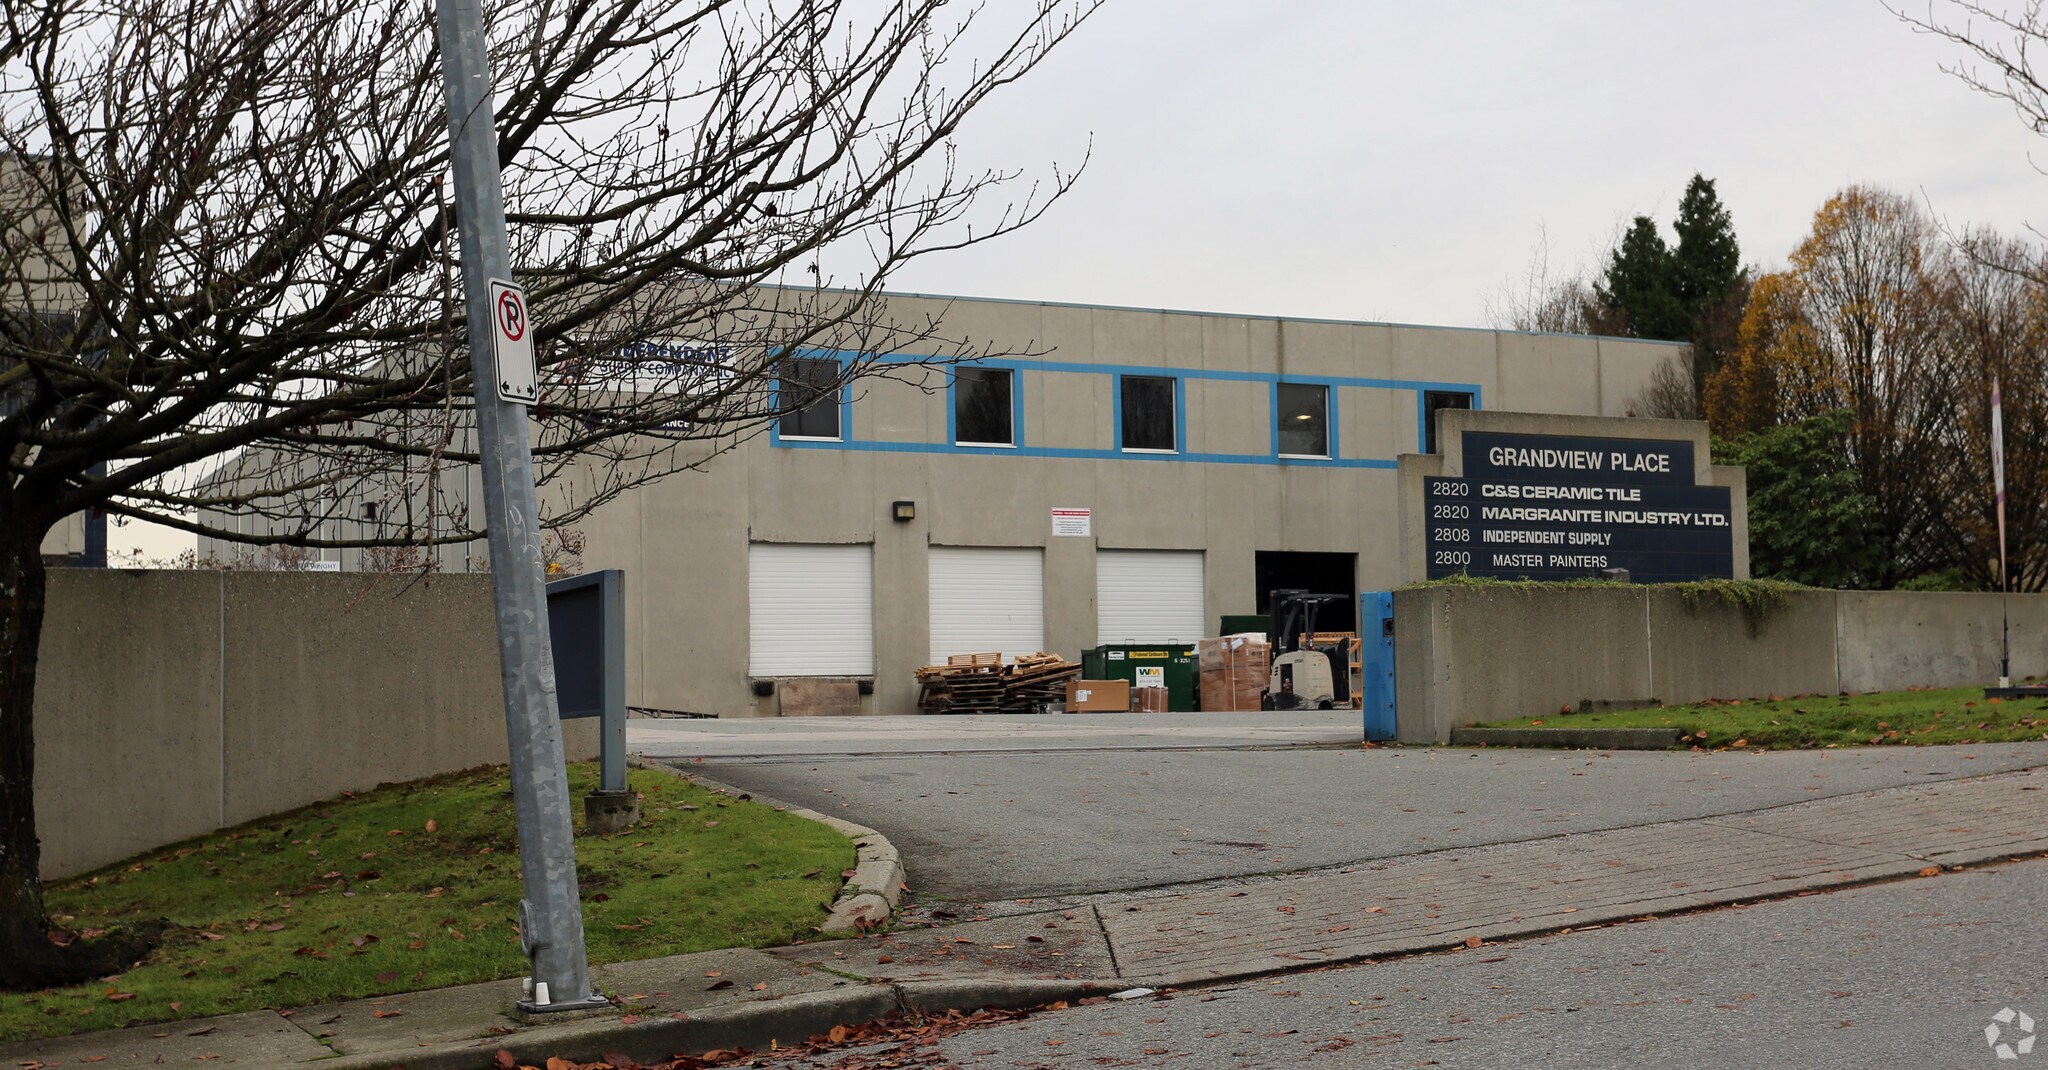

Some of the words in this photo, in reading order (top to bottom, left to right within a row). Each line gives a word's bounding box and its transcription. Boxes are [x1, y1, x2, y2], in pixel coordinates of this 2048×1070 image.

[603, 342, 729, 362] DEPENDENT
[1489, 446, 1604, 470] GRANDVIEW
[1610, 452, 1670, 473] PLACE
[1433, 481, 1469, 497] 2820
[1481, 484, 1520, 499] C&S
[1522, 485, 1603, 501] CERAMIC
[1605, 488, 1642, 502] TILE
[1433, 504, 1470, 519] 2820
[1481, 506, 1603, 523] MARGRANITE
[1604, 510, 1692, 526] INDUSTRY
[1694, 513, 1729, 527] LTD.
[1434, 528, 1470, 542] 2808
[1482, 529, 1566, 545] INDEPENDENT
[1568, 532, 1612, 546] SUPPLY
[1435, 550, 1471, 565] 2800
[1492, 554, 1544, 567] MASTER
[1549, 555, 1608, 568] PAINTERS
[1139, 668, 1161, 676] WM
